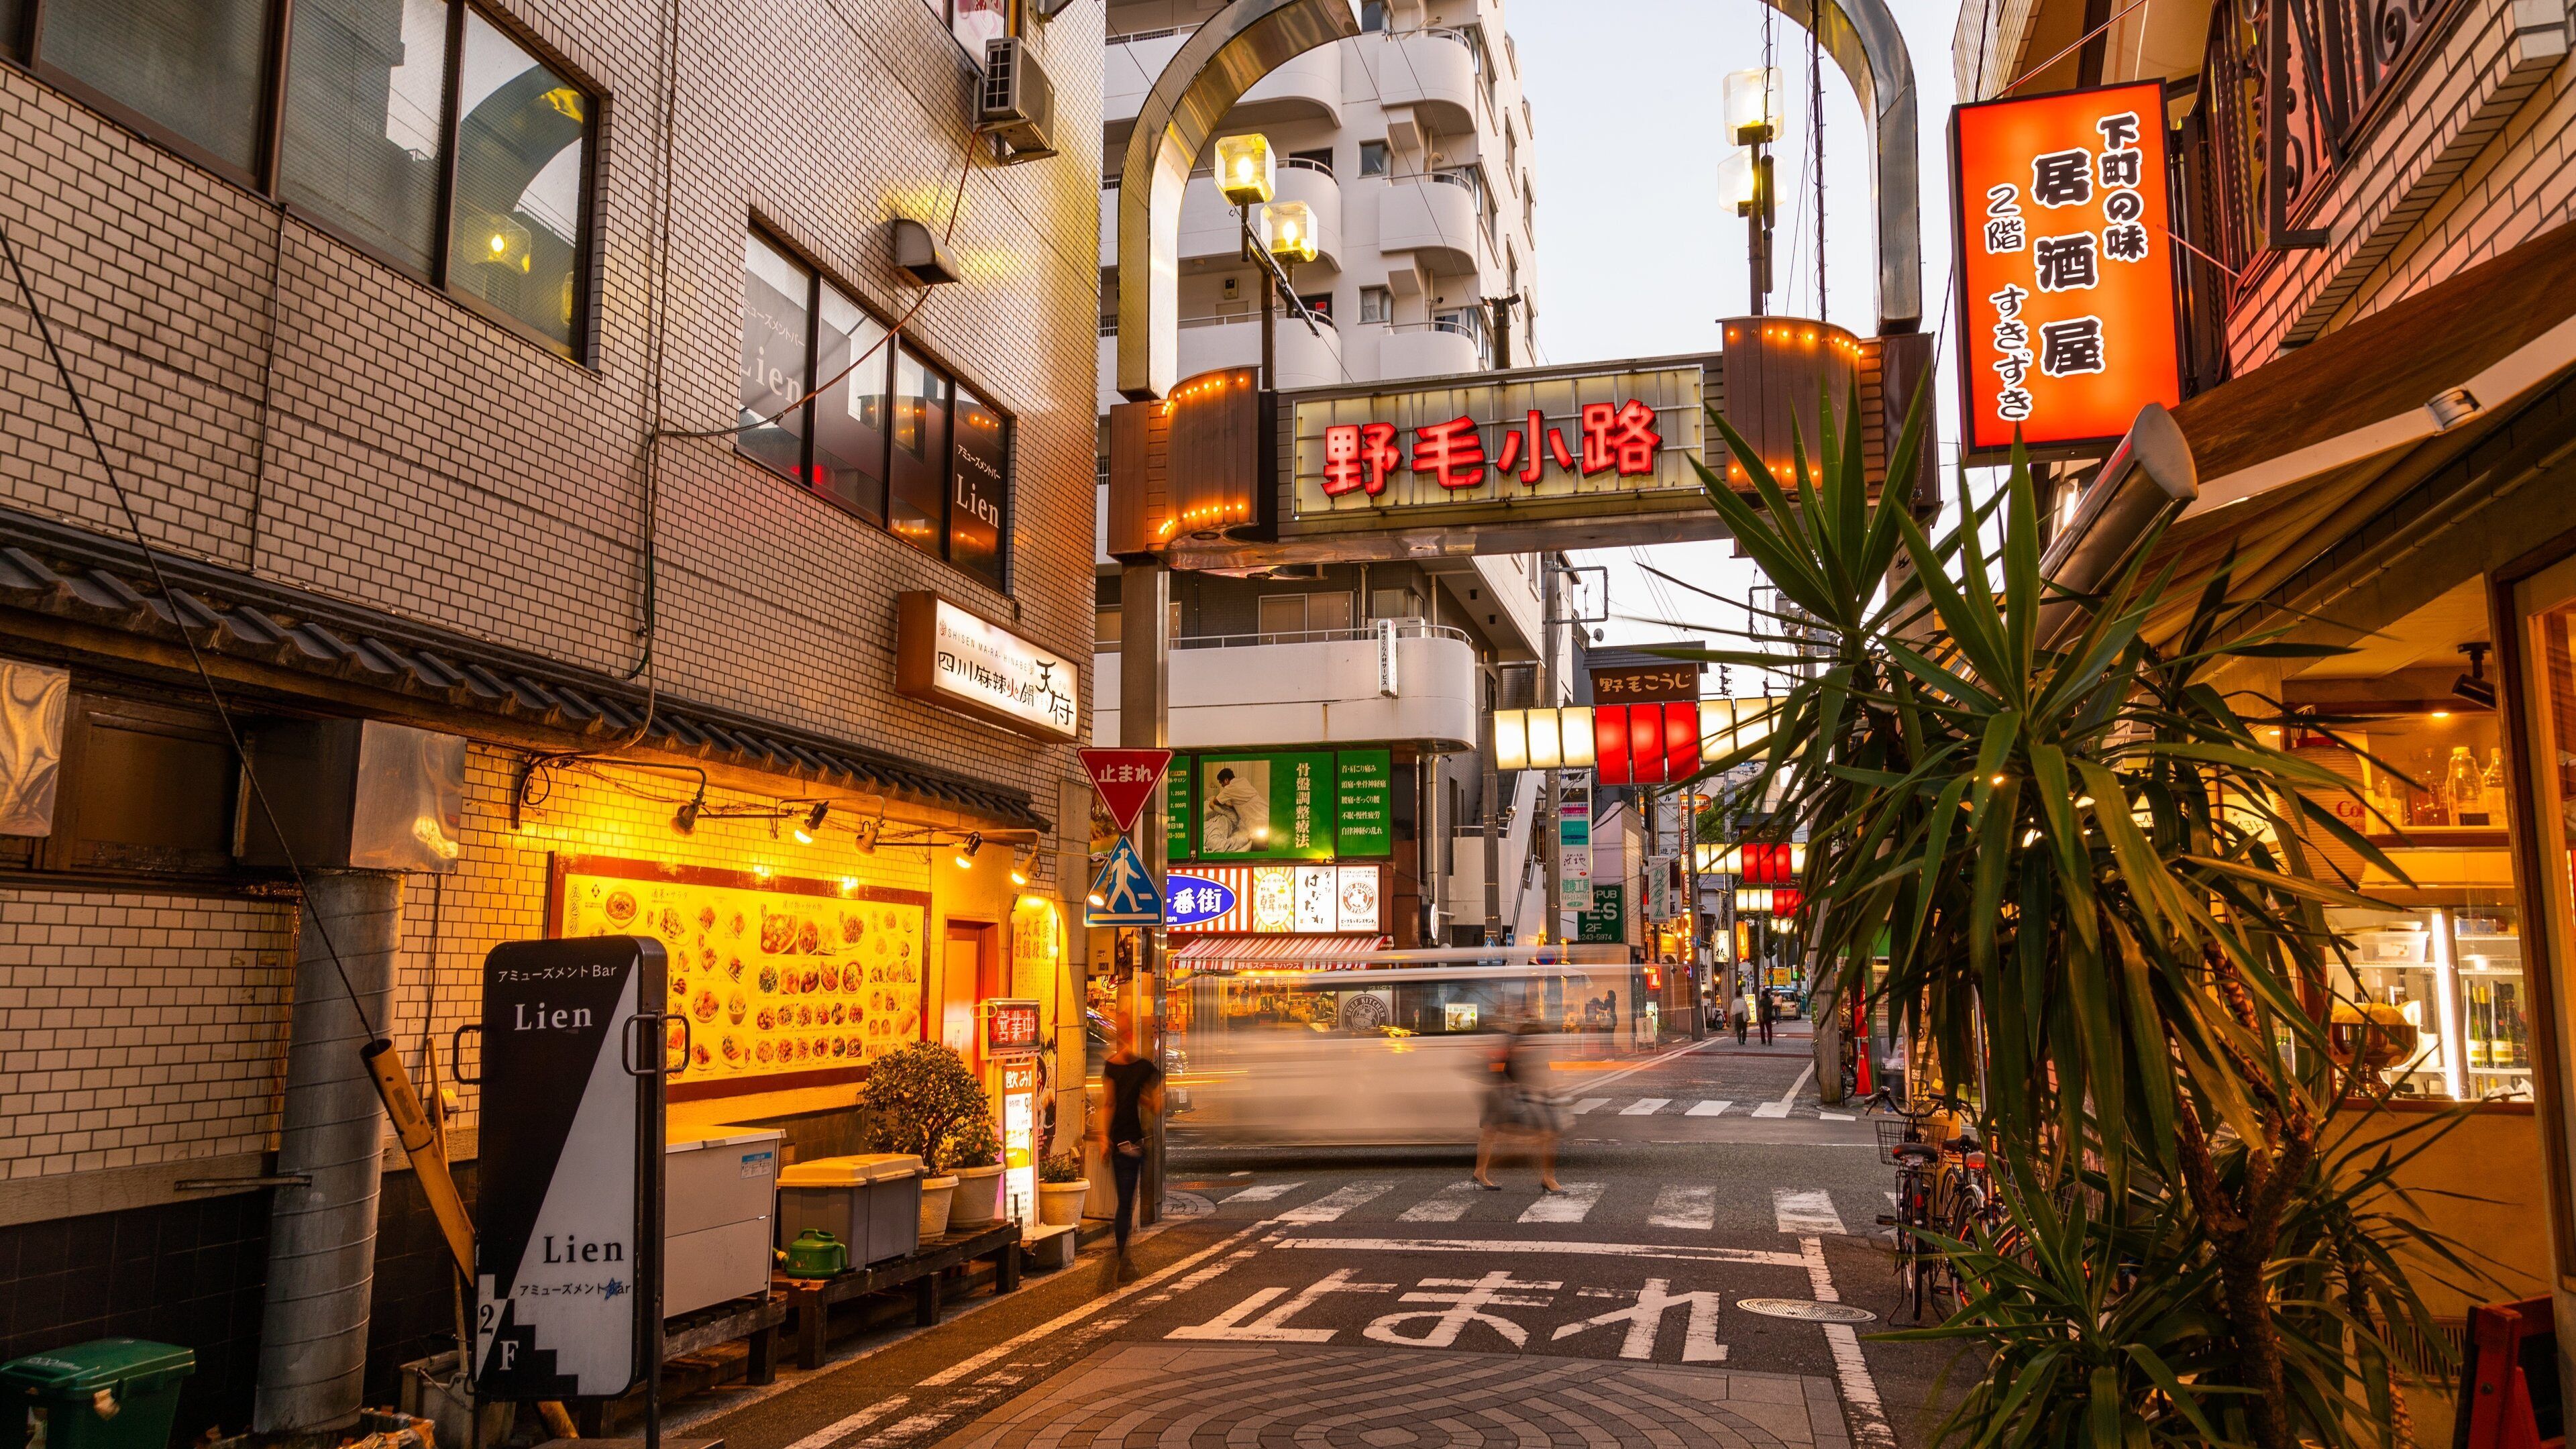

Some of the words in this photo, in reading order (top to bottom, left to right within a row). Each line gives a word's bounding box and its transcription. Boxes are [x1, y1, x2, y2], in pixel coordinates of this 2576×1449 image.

[2098, 113, 2147, 260] 下町の味
[1988, 187, 2023, 252] 2階
[2033, 150, 2104, 374] 居酒屋
[1992, 287, 2031, 419] すきずき
[957, 444, 1001, 480] アミューズメントバー
[1321, 398, 1662, 497] 野毛小路
[956, 474, 999, 529] Lien
[948, 629, 975, 649] SHISEN
[938, 651, 1034, 707] 四川麻辣火鍋
[1036, 659, 1074, 726] 天府
[1599, 673, 1691, 694] 野毛こうじ
[1098, 763, 1154, 783] 止まれ
[1342, 764, 1377, 774] 首・肩こり痛み
[1342, 779, 1387, 790] 頭痛・坐骨神経痛
[1342, 795, 1380, 804] 腰痛・ぎっくり腰
[1295, 762, 1311, 849] 骨盤調整療法
[1342, 811, 1381, 820] 不眠・慢性疲労
[1342, 826, 1383, 836] 自律神経の乱れ
[1585, 923, 1602, 932] 2F
[514, 1002, 592, 1032] Lien
[1345, 1000, 1358, 1017] BEEF
[1361, 997, 1386, 1018] KITCHEN
[998, 1010, 1035, 1041] 営業中
[542, 1236, 625, 1264] Lien
[1164, 1268, 1729, 1362] 止まれ
